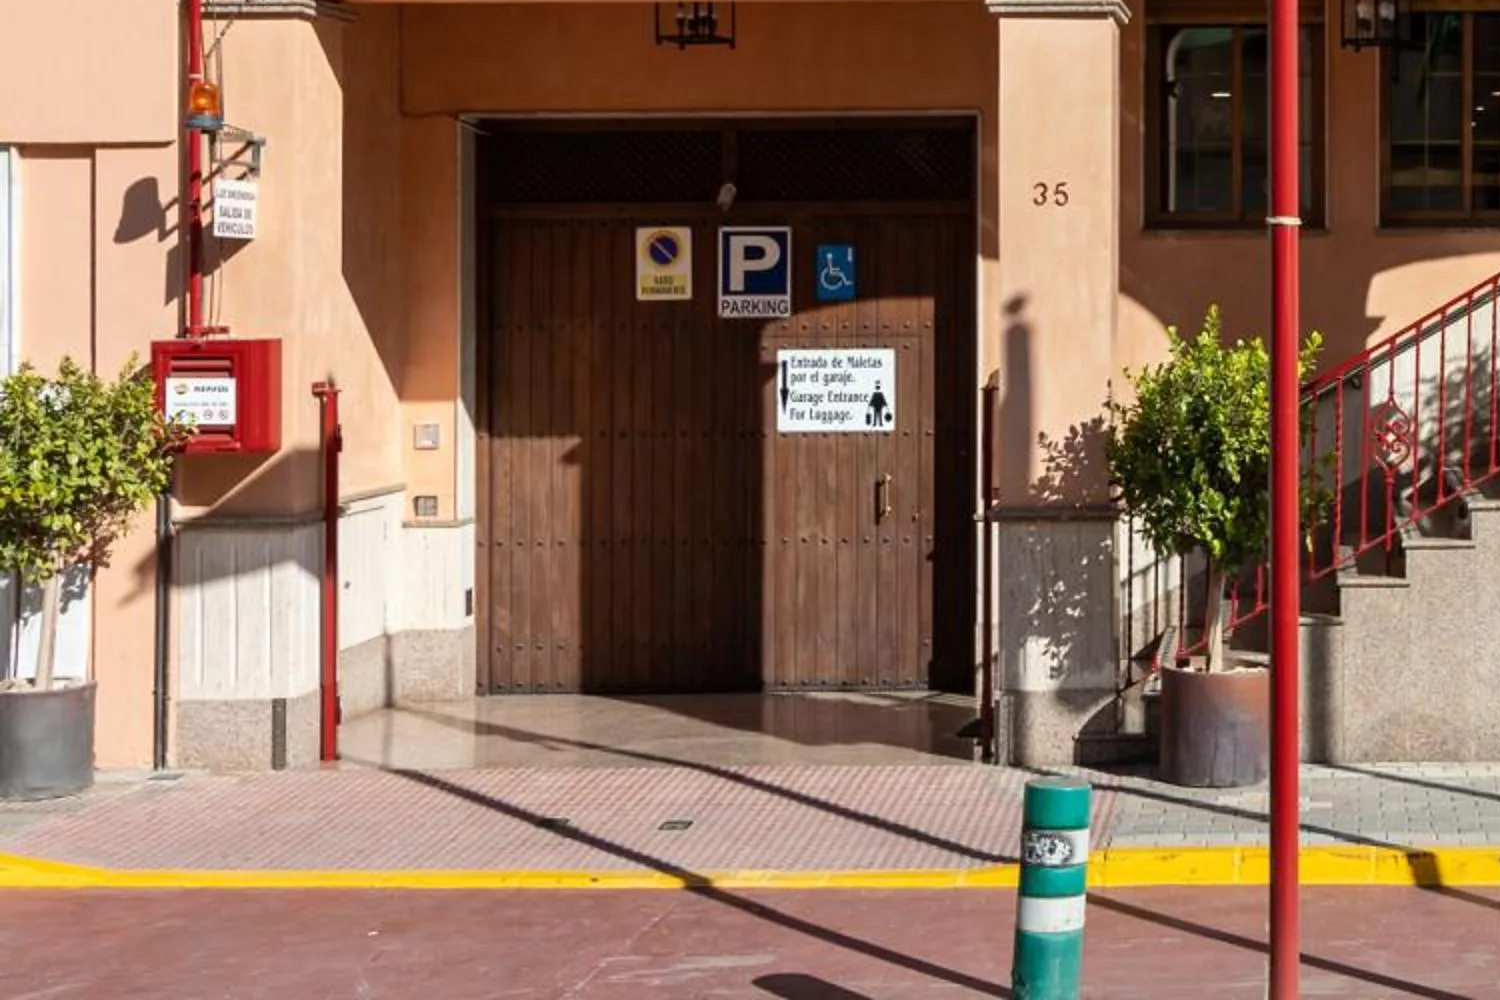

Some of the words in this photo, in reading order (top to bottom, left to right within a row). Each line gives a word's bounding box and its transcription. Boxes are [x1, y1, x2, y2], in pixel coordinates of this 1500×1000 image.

[1033, 181, 1069, 207] 35
[219, 205, 242, 218] SALIDA
[729, 235, 781, 292] P
[721, 300, 789, 315] PARKING
[790, 355, 828, 368] Entrada
[831, 355, 843, 368] de
[847, 355, 883, 368] Maletas
[790, 373, 807, 386] por
[810, 371, 819, 382] el
[823, 371, 856, 386] garaje.
[790, 391, 824, 406] Garage
[827, 390, 869, 402] Entrance
[789, 408, 805, 420] For
[809, 408, 853, 424] Luggage.
